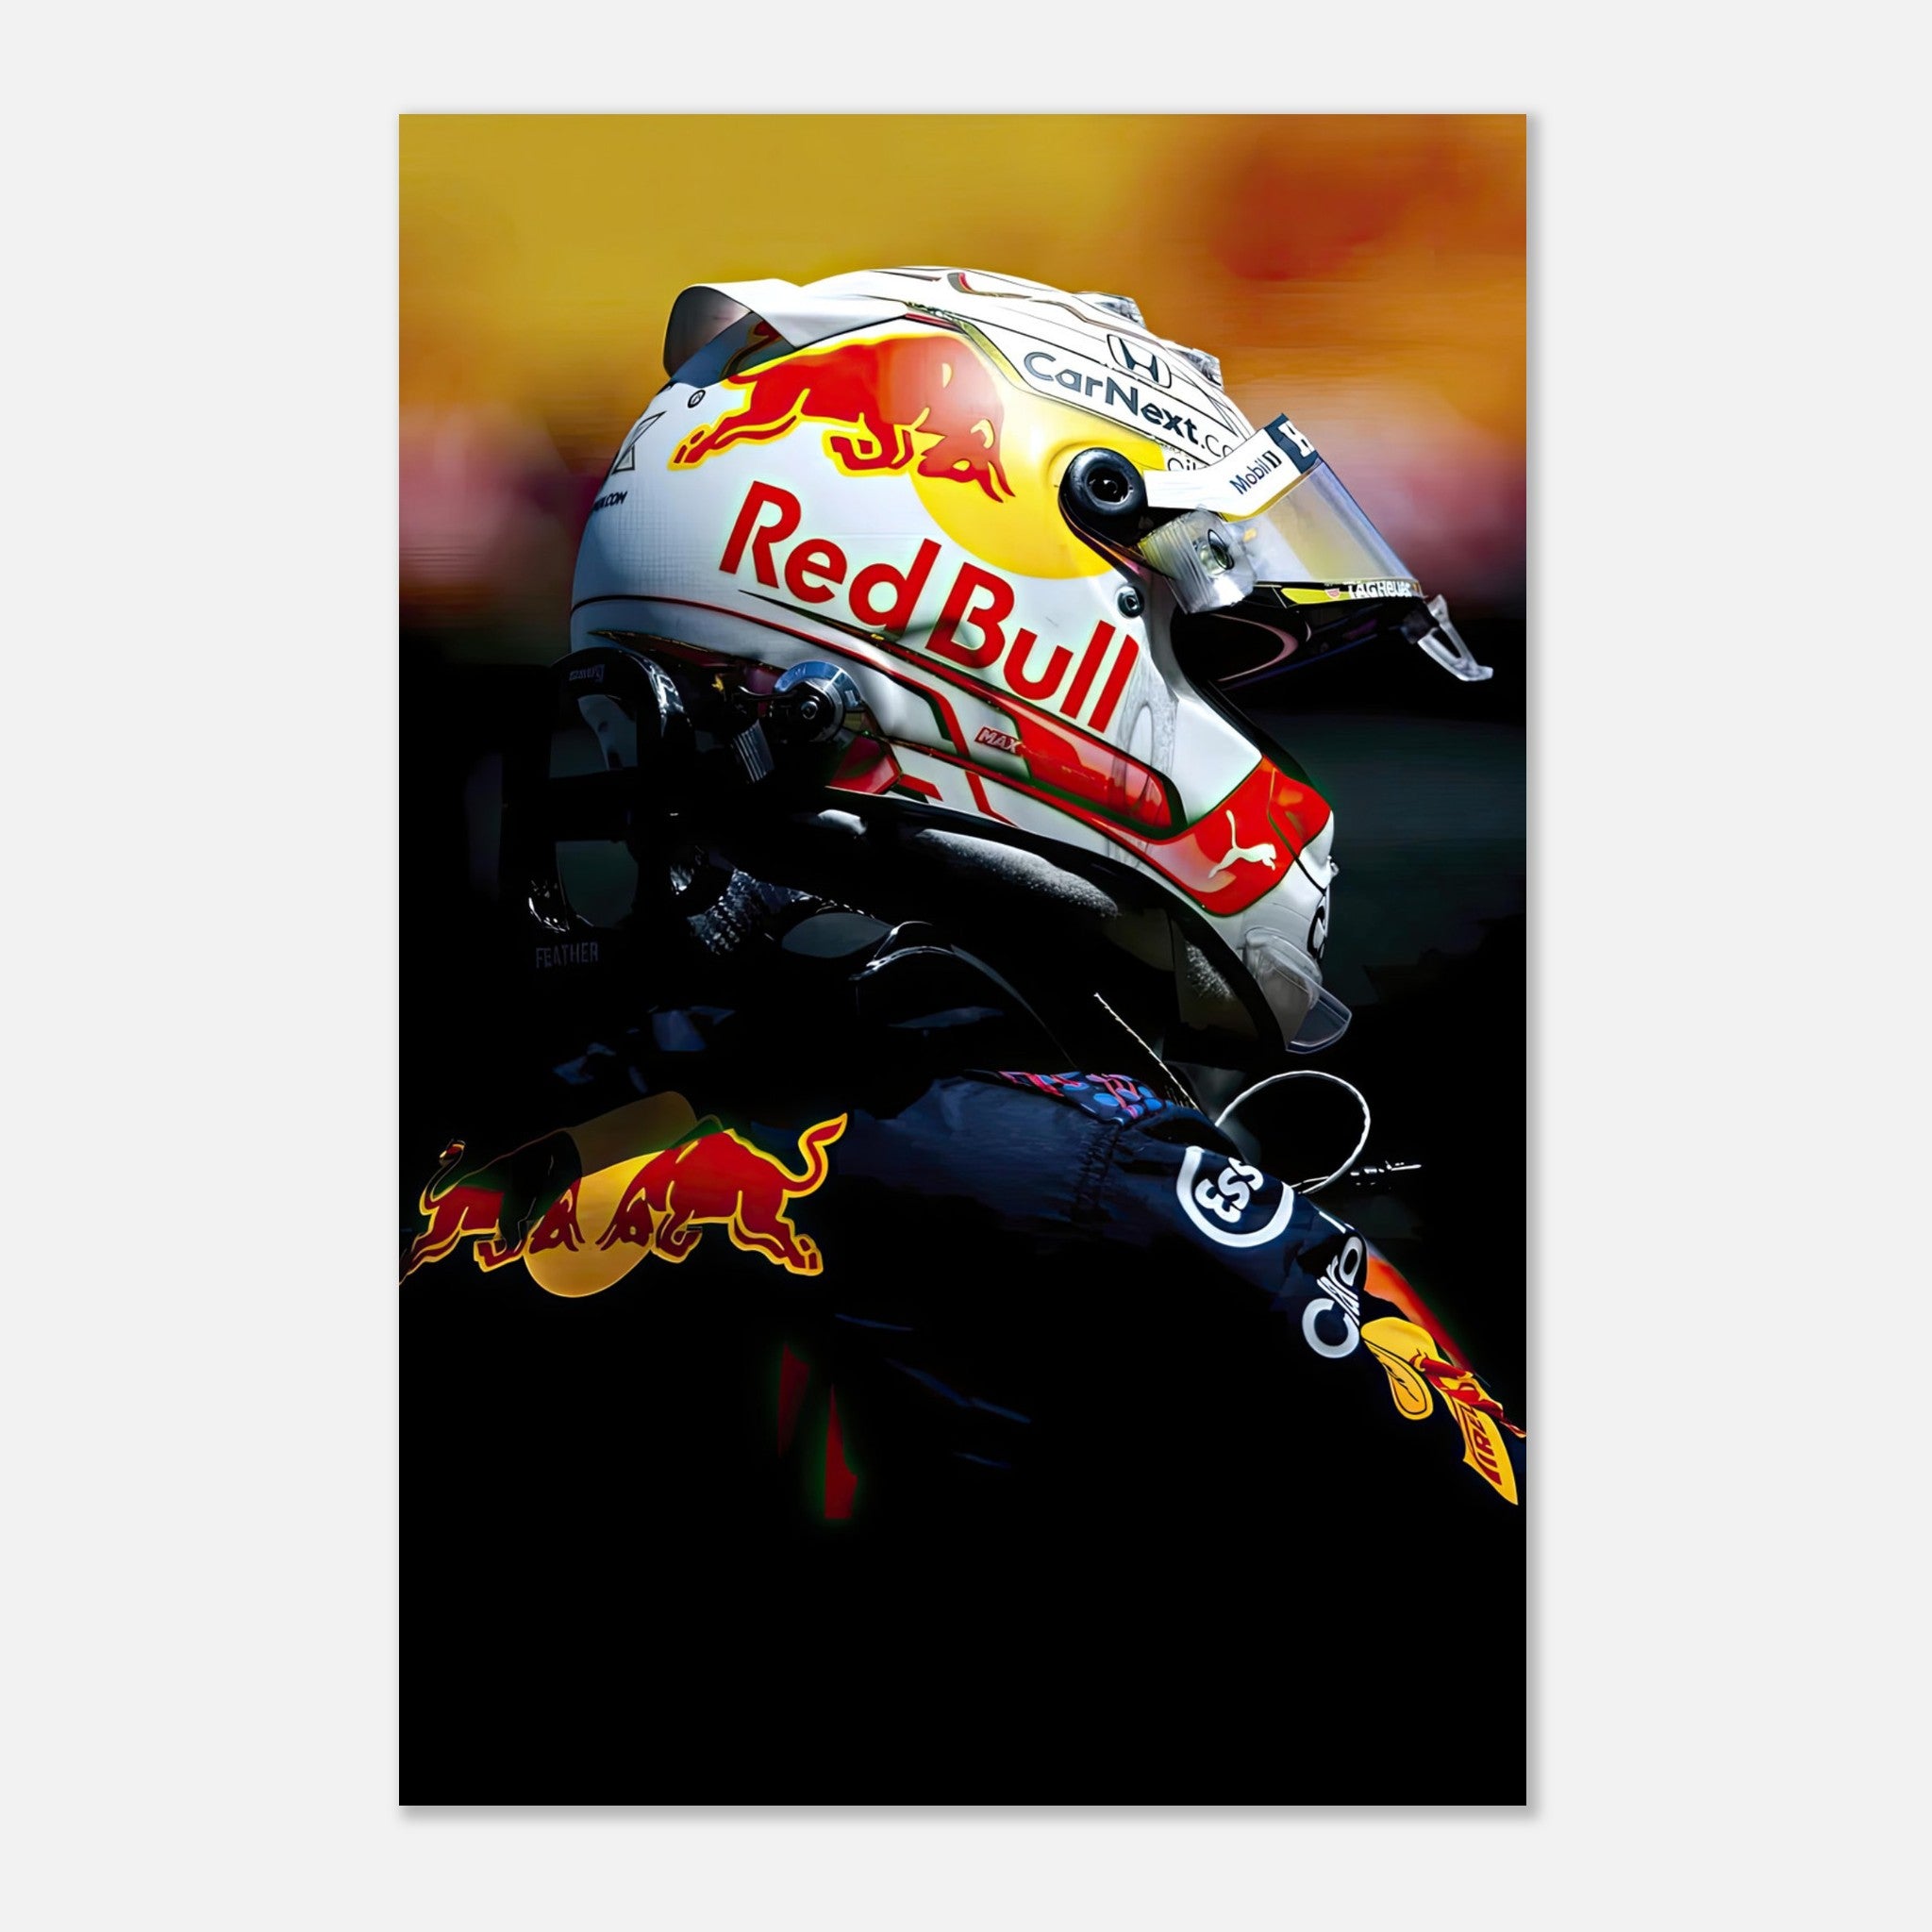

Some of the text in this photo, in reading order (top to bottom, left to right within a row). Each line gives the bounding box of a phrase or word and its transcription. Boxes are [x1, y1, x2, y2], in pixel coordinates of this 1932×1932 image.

[719, 480, 1140, 733] Red Bull
[977, 727, 1023, 754] MAX
[535, 941, 599, 969] FEATHER
